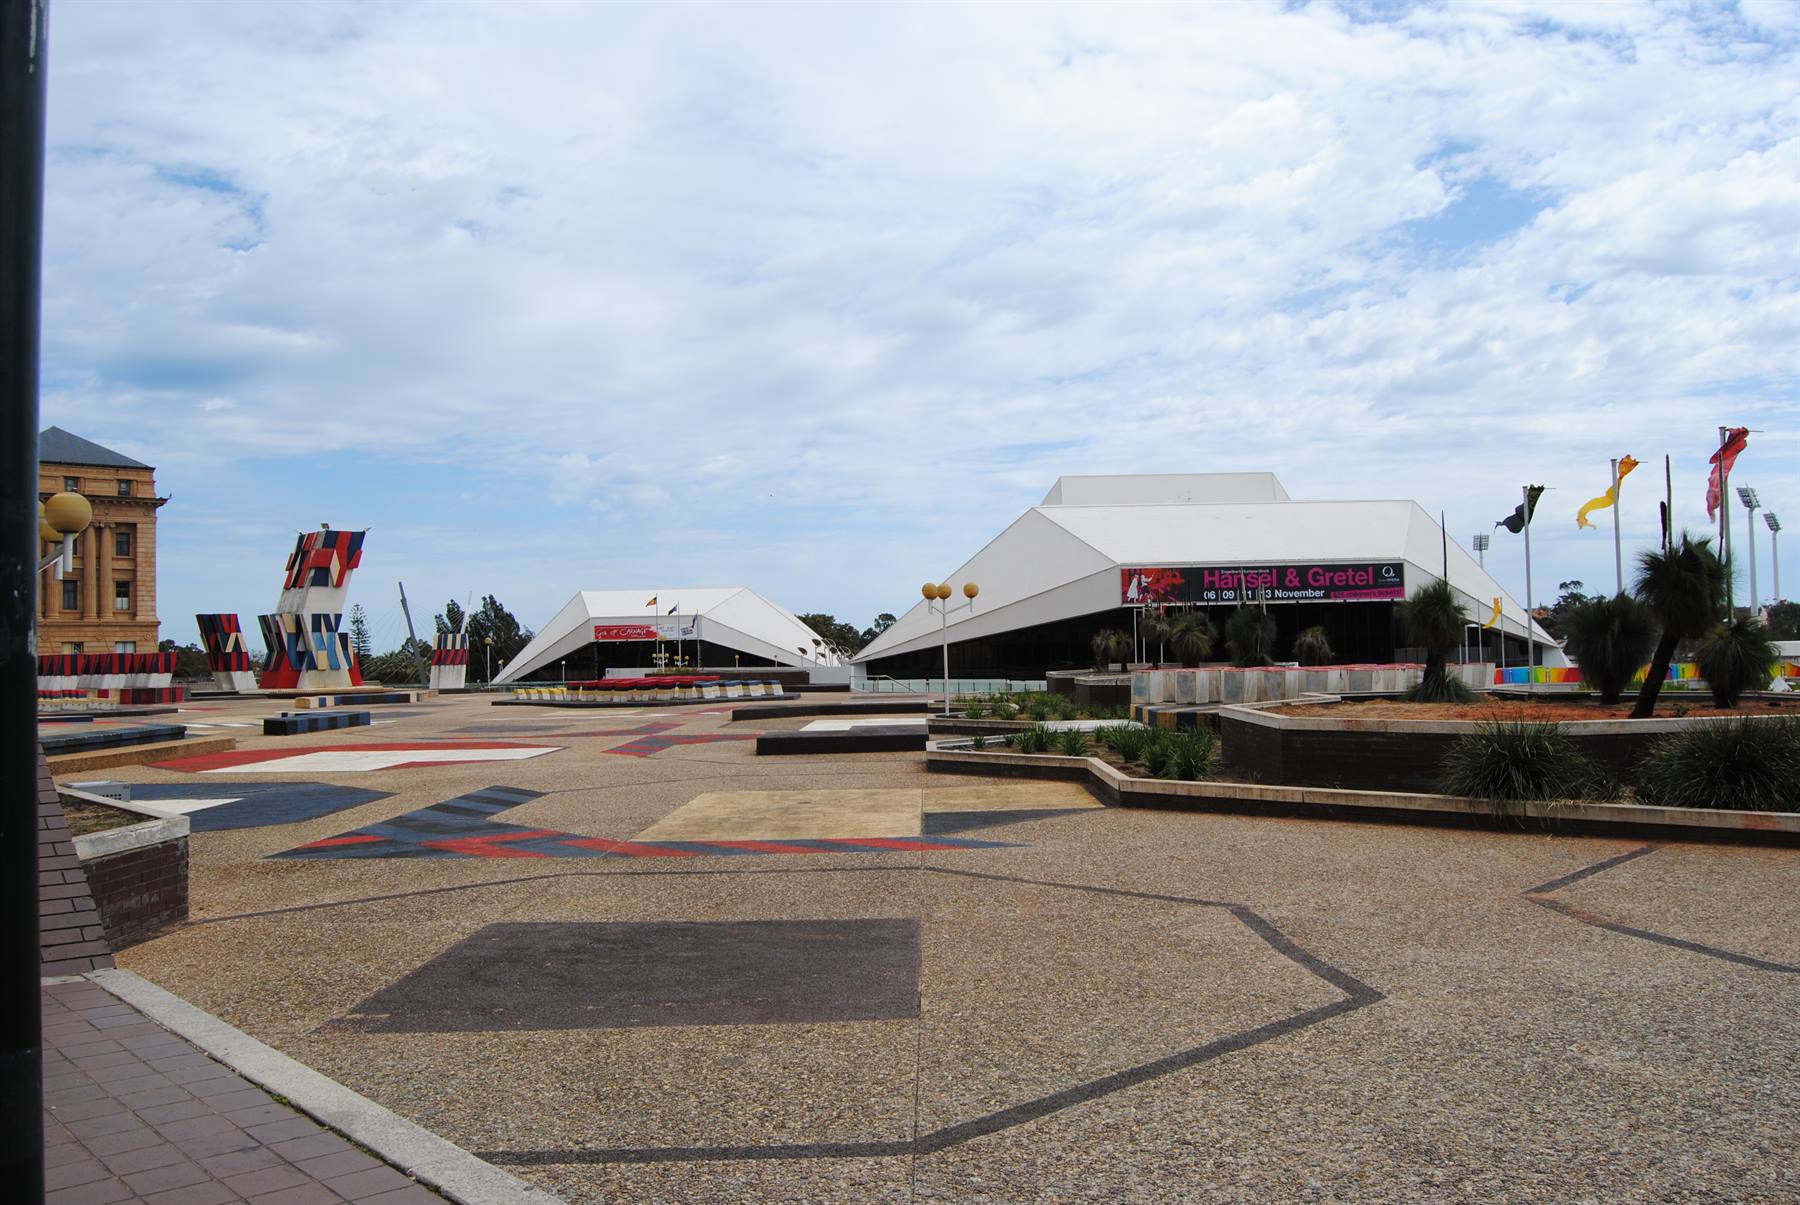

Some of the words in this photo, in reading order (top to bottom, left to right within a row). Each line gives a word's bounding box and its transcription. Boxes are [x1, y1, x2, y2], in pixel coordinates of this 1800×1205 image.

[1285, 568, 1301, 587] &
[1307, 566, 1374, 586] Gretel
[1222, 590, 1235, 599] 09
[1274, 588, 1325, 598] November
